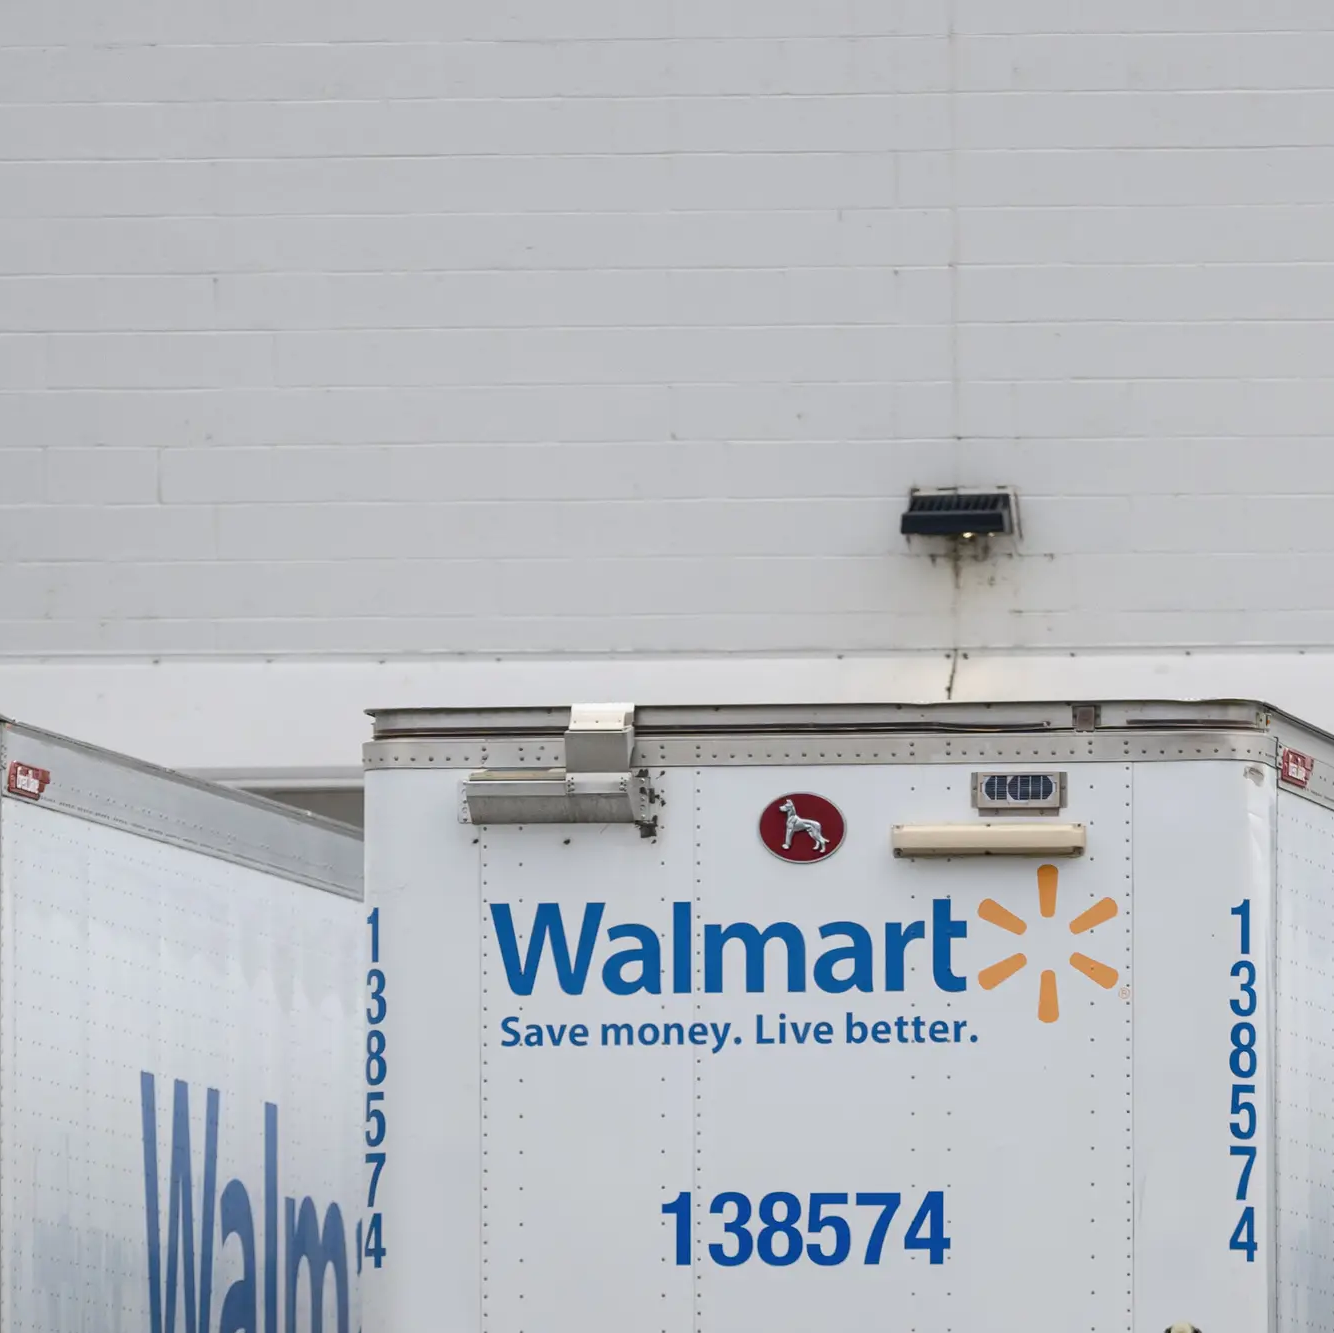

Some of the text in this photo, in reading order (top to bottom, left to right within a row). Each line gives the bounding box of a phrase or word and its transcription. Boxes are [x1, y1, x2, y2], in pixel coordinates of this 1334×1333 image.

[490, 898, 968, 997] Walmart
[501, 1013, 979, 1055] Save money. Live better.
[1229, 899, 1258, 1265] 138574
[365, 907, 387, 1270] 138574
[661, 1191, 952, 1268] 138574
